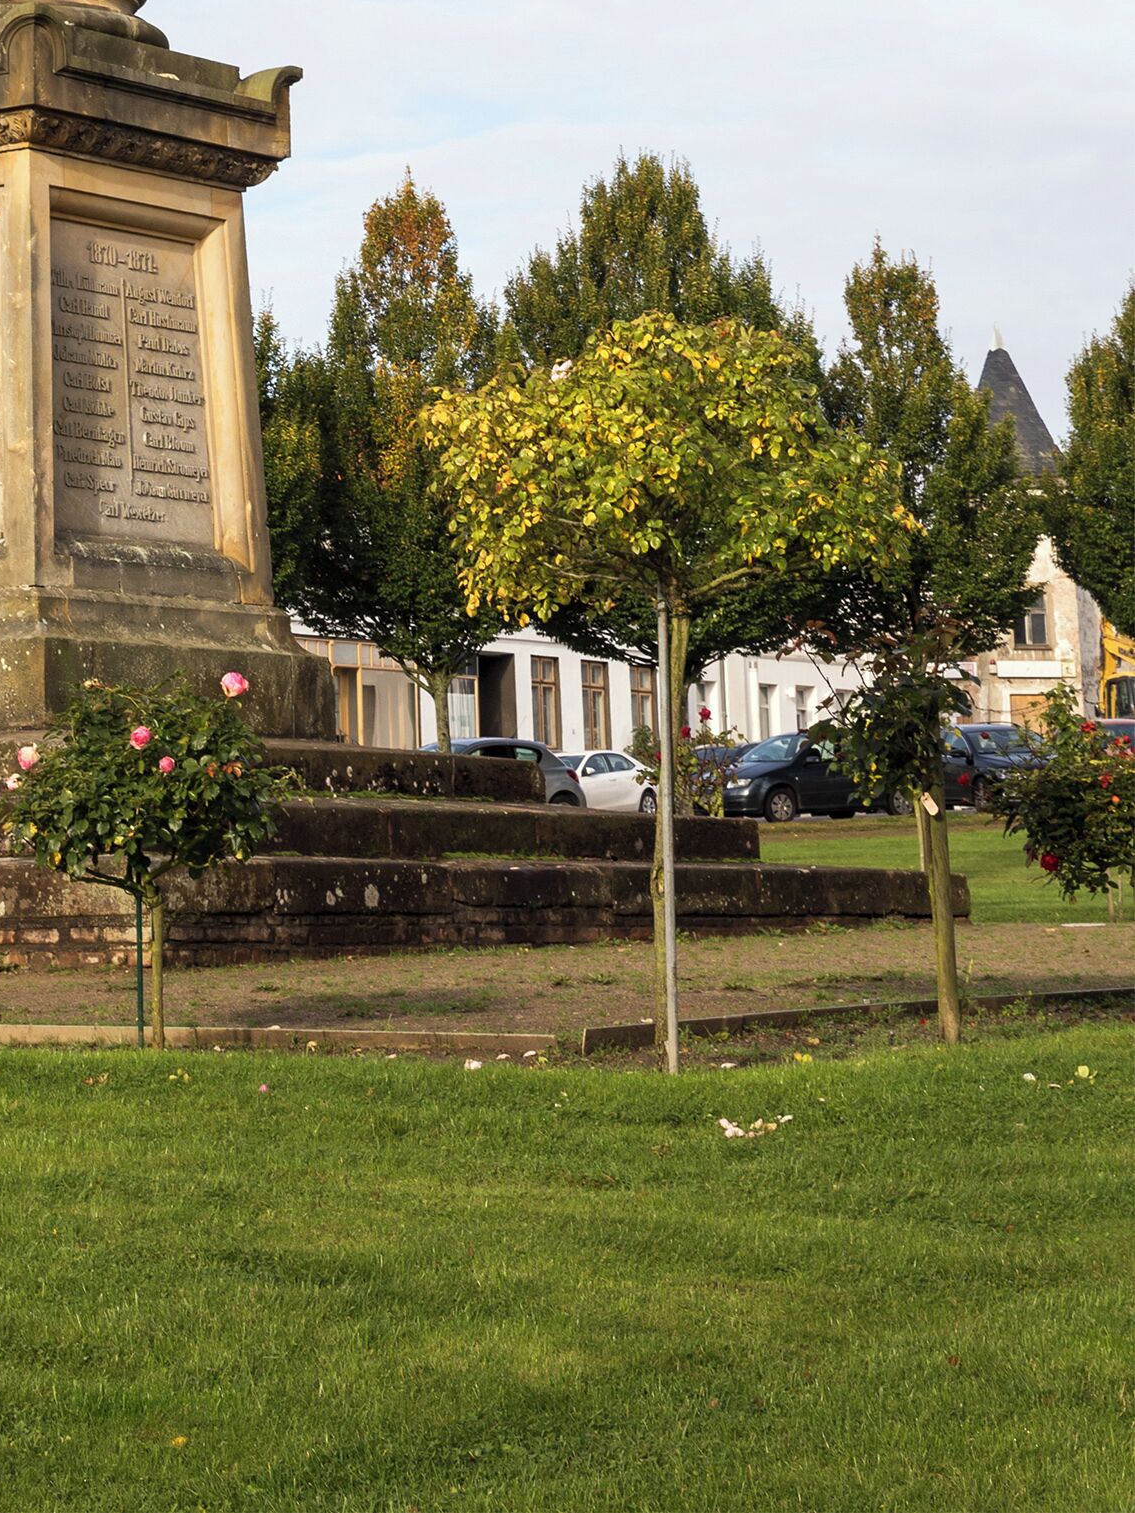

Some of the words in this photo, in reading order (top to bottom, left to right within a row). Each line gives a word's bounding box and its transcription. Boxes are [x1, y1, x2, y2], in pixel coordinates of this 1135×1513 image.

[125, 282, 157, 305] August
[59, 296, 80, 315] Carl
[129, 307, 147, 326] Carl
[137, 334, 160, 351] Paul
[134, 357, 165, 377] Martin
[64, 371, 83, 389] Carl
[63, 397, 82, 414] Carl
[140, 405, 172, 426] Gustav
[143, 431, 163, 449] Carl
[99, 497, 119, 518] Carl
